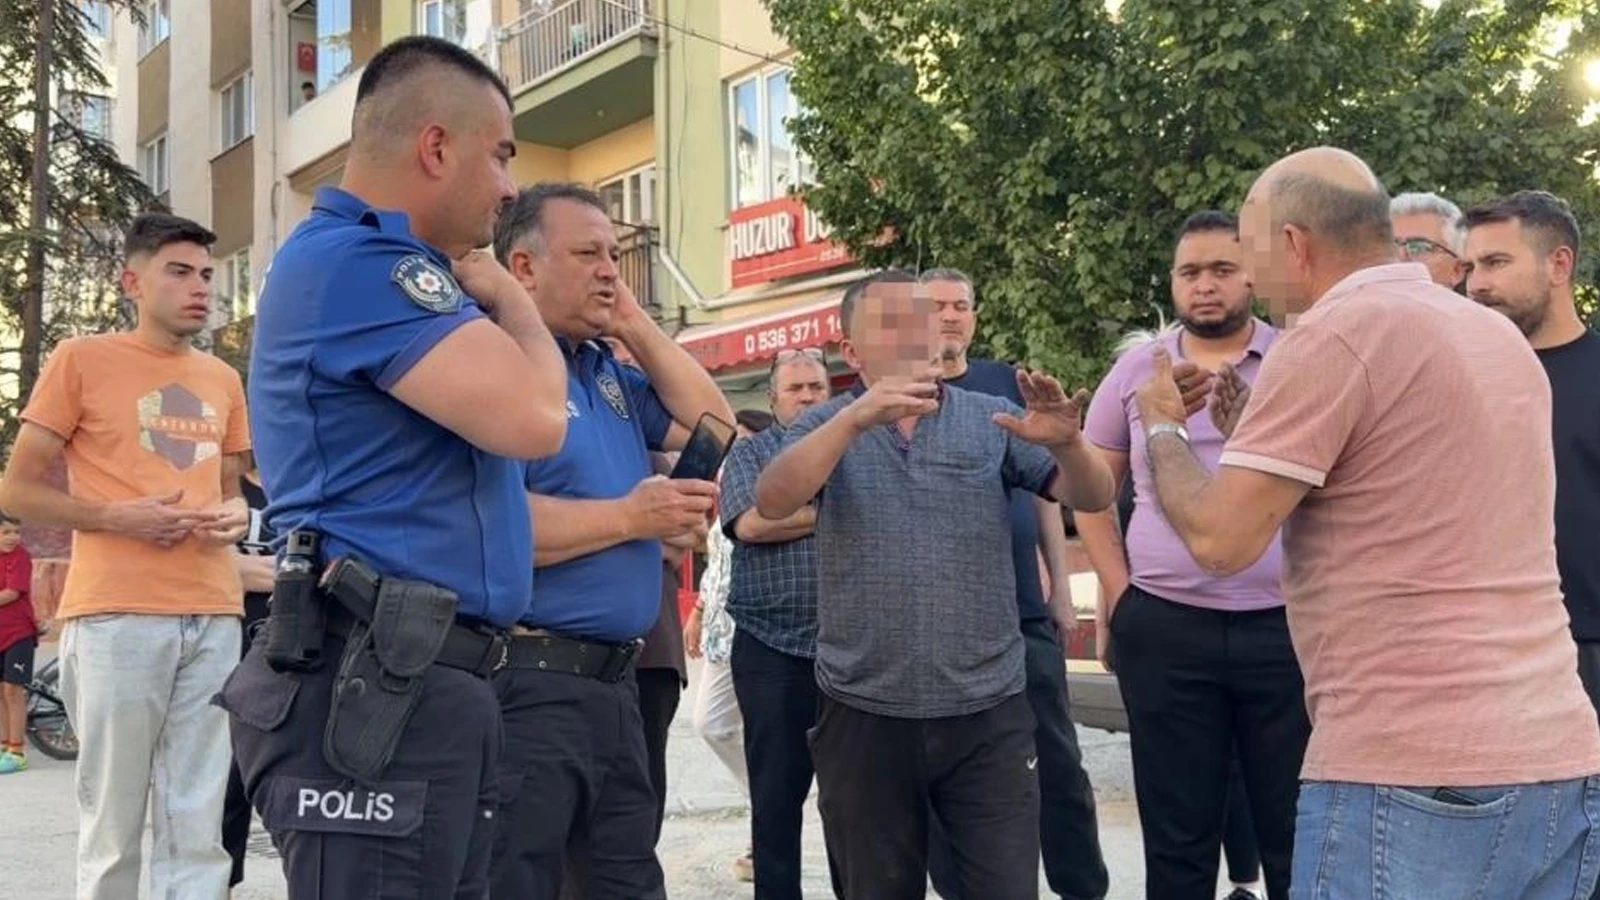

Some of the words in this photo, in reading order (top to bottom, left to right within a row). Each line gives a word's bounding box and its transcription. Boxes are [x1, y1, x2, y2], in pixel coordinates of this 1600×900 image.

[730, 212, 791, 260] HUZUR
[744, 334, 755, 354] 0
[758, 326, 787, 350] 536
[790, 318, 819, 342] 371
